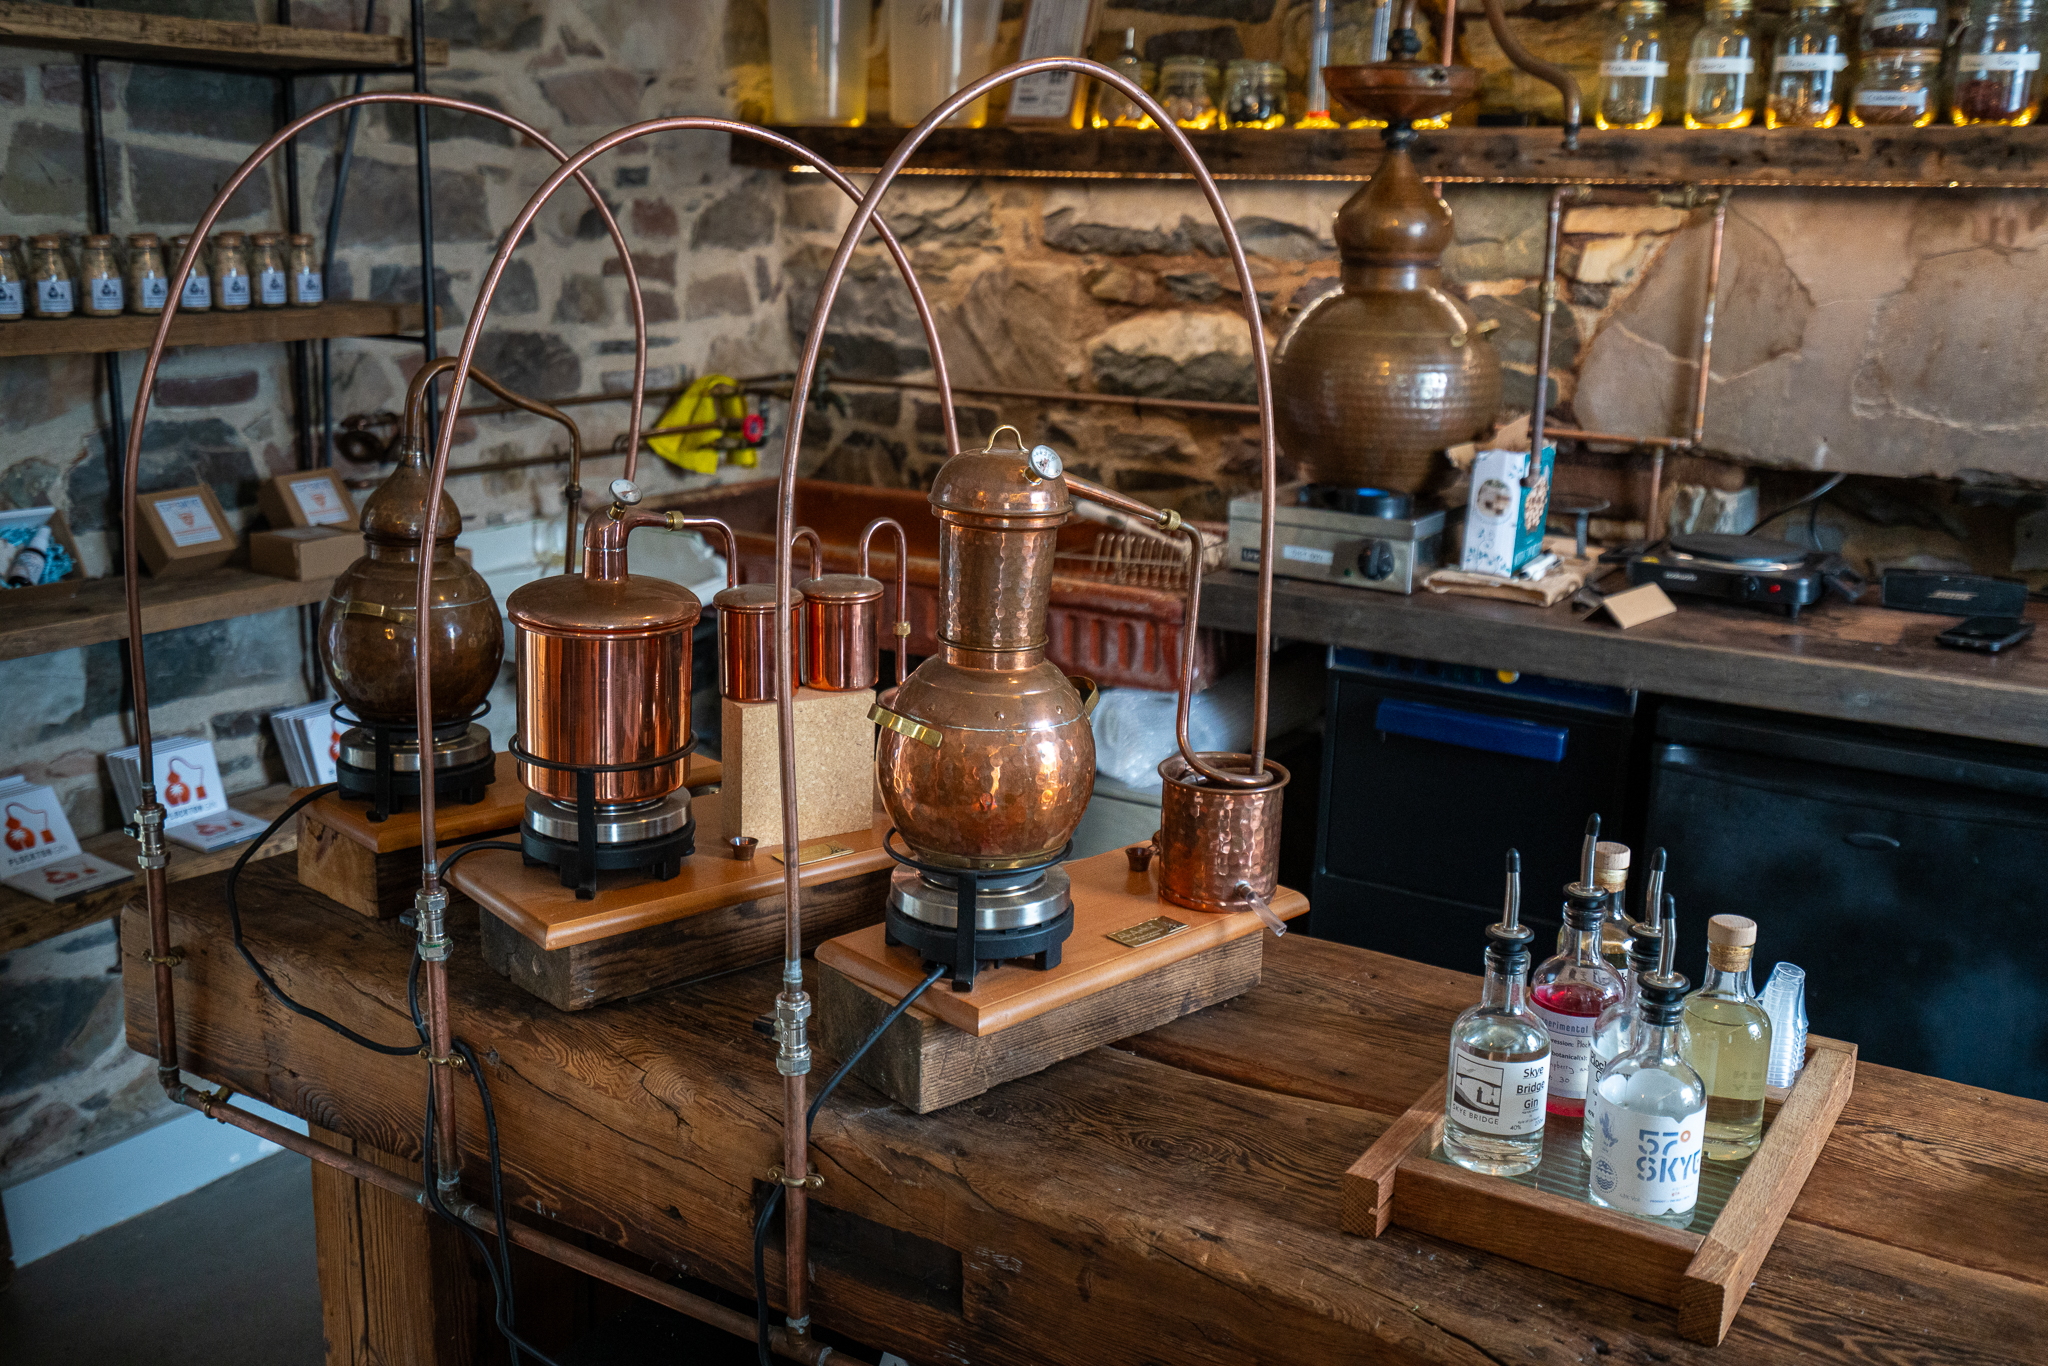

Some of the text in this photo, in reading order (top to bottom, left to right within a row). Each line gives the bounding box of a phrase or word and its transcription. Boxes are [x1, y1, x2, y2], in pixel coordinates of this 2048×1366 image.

[1523, 1066, 1544, 1080] Skye
[1516, 1081, 1545, 1096] Bridge
[1524, 1098, 1539, 1109] Gin
[1452, 1103, 1499, 1126] SKYE BRIDGE
